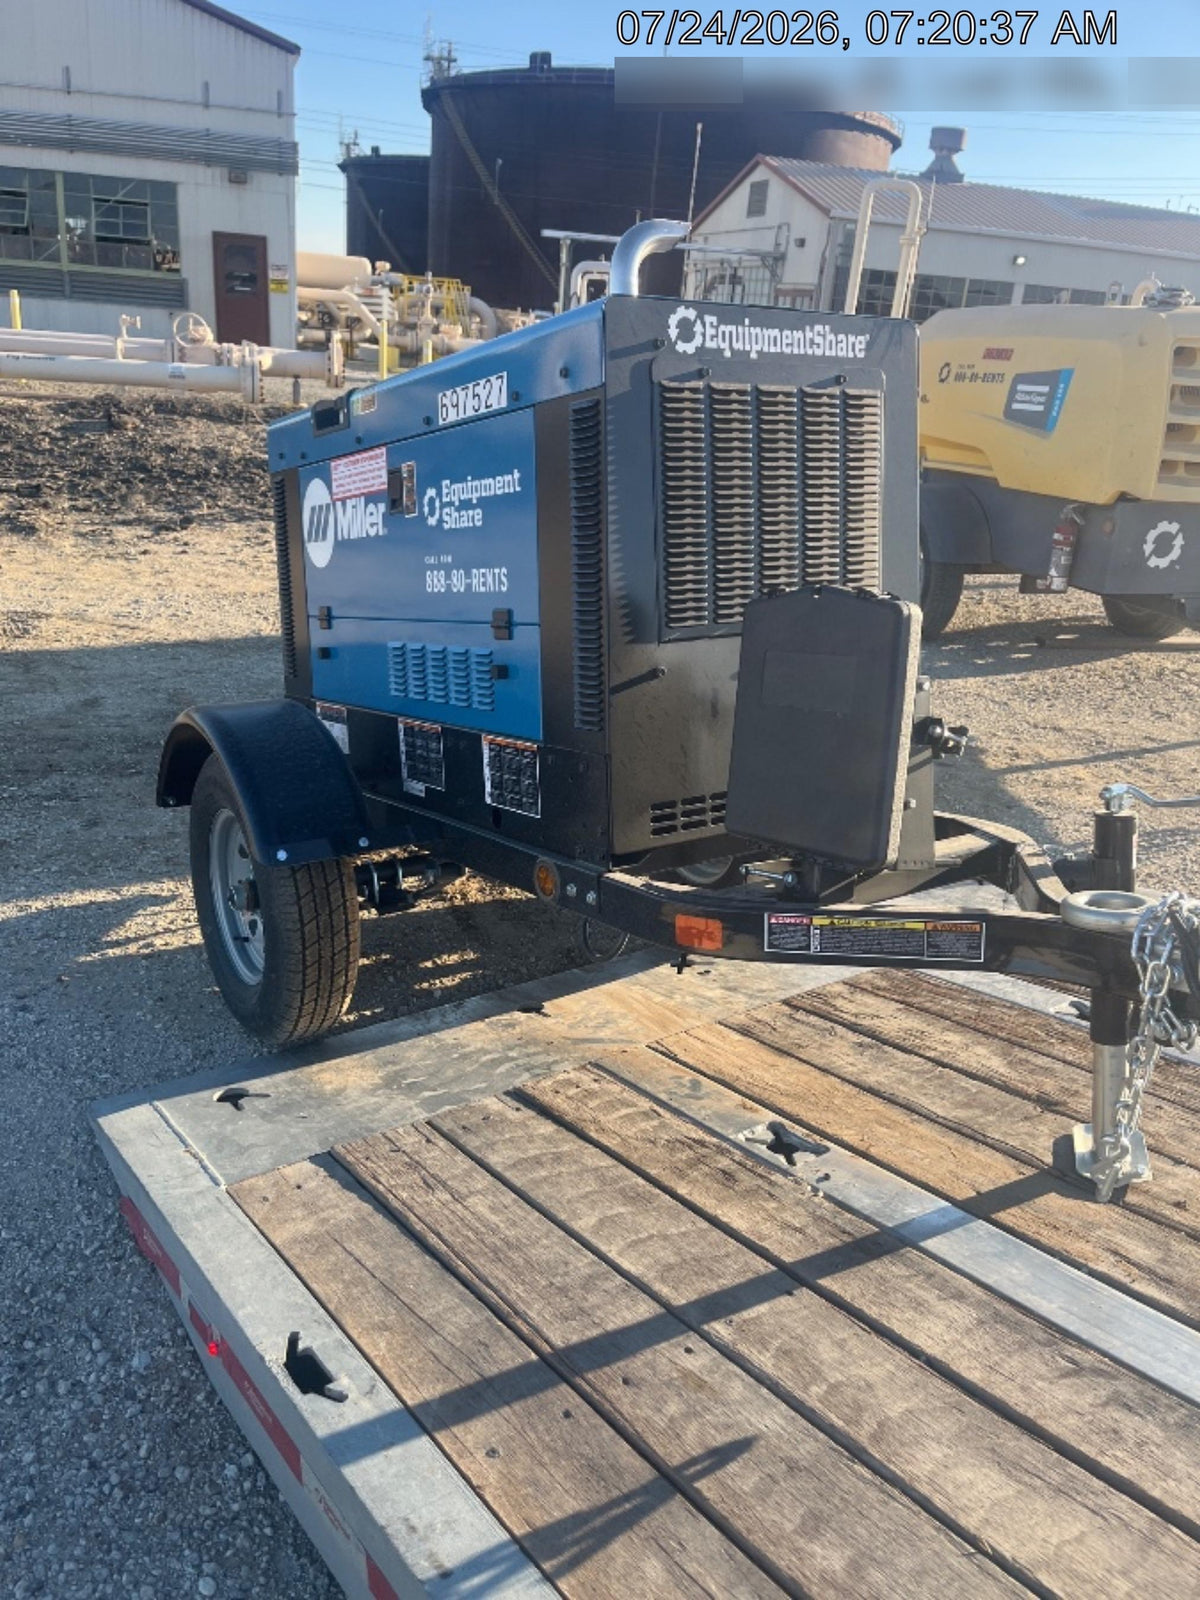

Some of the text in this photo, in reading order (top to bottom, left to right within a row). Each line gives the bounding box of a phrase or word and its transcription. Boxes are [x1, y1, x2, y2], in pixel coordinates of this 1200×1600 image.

[440, 374, 506, 422] 697527
[441, 468, 521, 504] Equipment
[336, 496, 387, 541] Miller
[441, 507, 483, 530] Share
[425, 566, 508, 593] 888-80-RENTS
